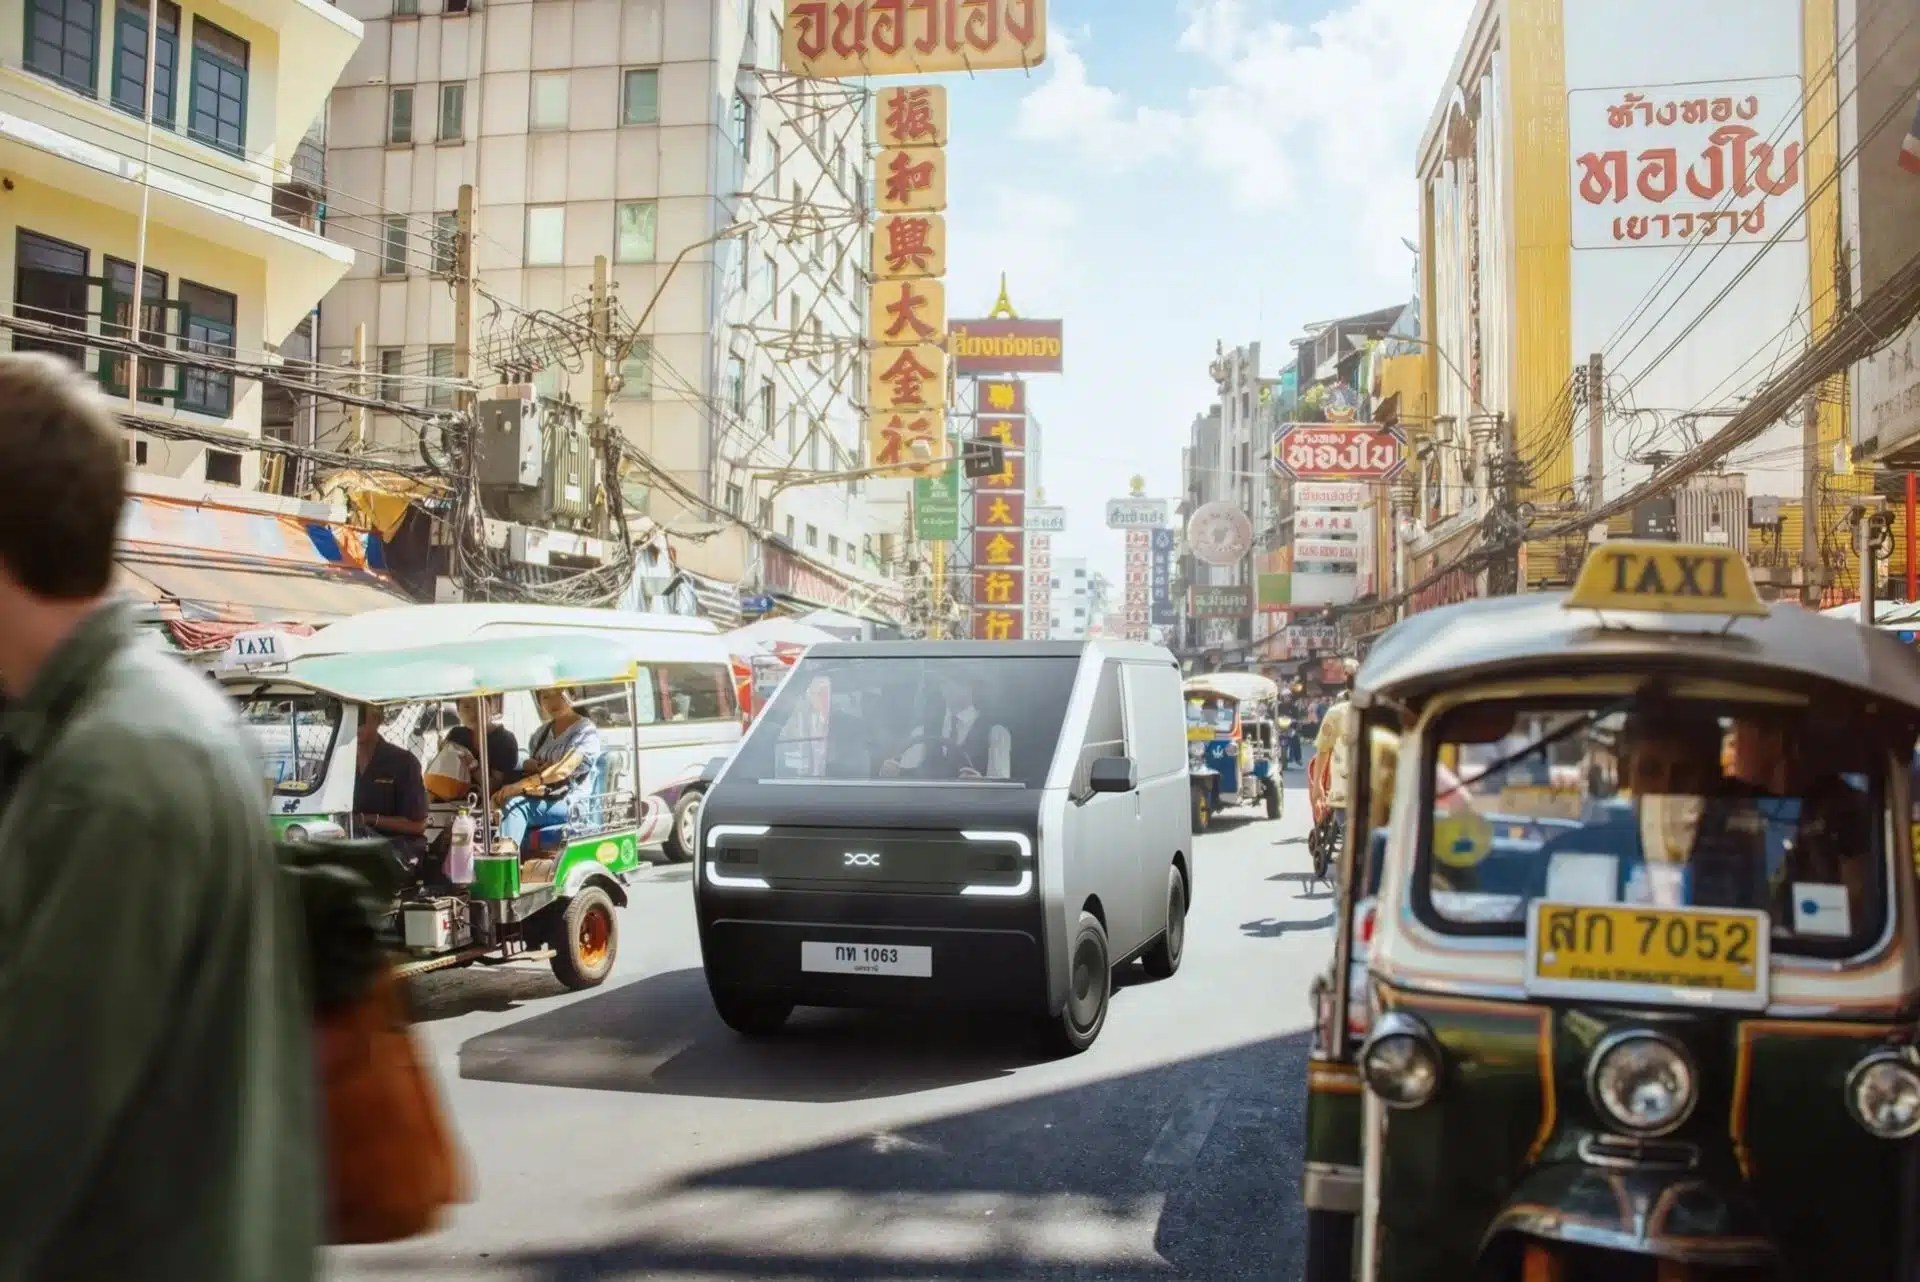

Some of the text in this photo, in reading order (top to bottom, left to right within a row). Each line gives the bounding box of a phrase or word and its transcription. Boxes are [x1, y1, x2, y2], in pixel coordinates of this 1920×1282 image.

[1606, 93, 1758, 128] ห้างทอง
[1576, 124, 1800, 205] ทองใบ
[1613, 200, 1766, 241] เยาวราช
[876, 87, 939, 473] 振和興大金行
[1287, 432, 1394, 470] ทองใบ
[1606, 552, 1729, 598] TAXI
[236, 636, 276, 655] TAXI
[863, 947, 898, 963] 1063
[1550, 908, 1752, 964] สก 7052
